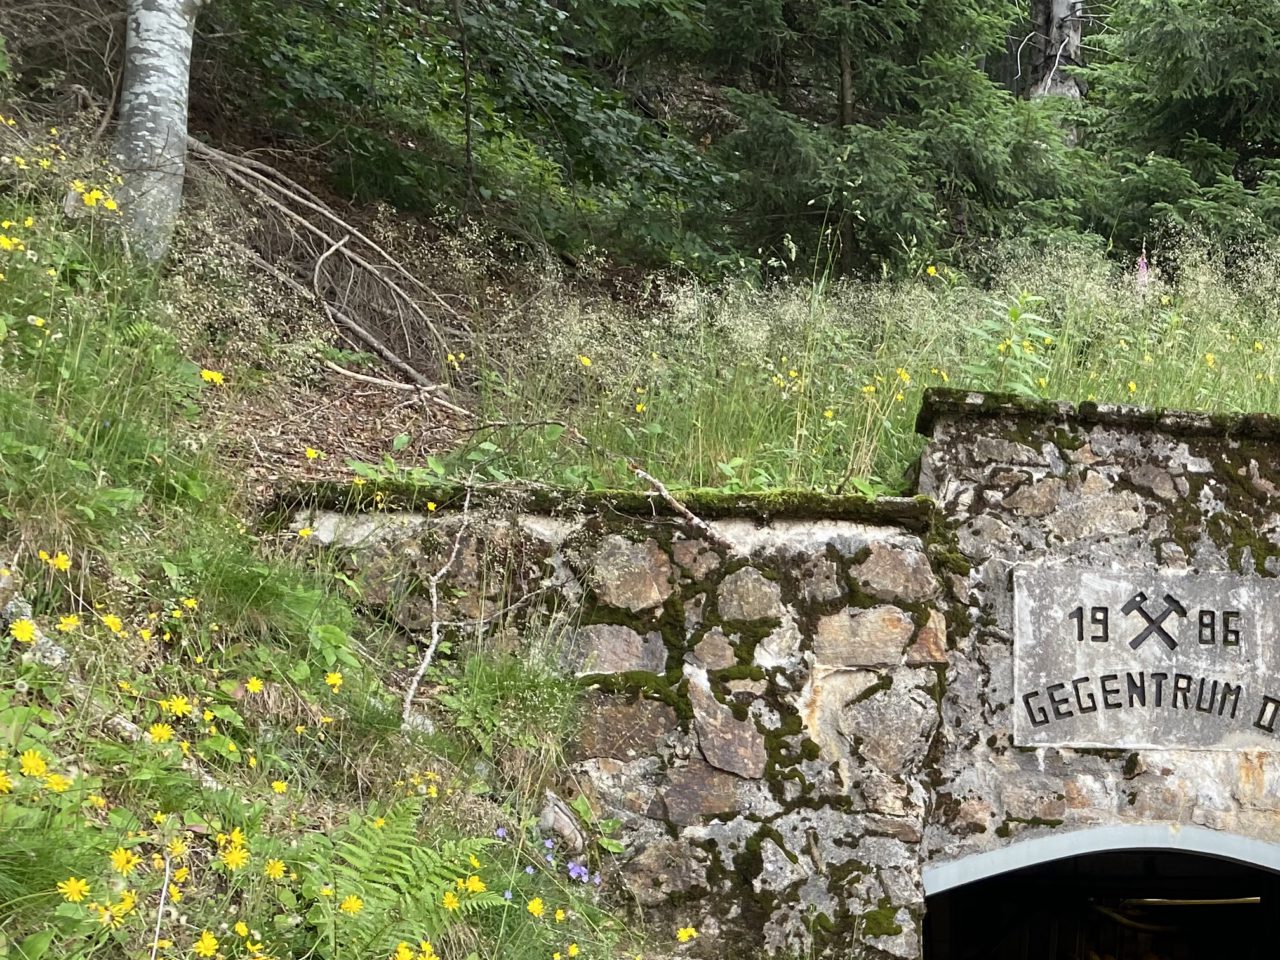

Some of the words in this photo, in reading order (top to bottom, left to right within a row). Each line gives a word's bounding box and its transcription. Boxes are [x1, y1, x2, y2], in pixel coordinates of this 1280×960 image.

[1068, 606, 1109, 642] 19
[1198, 610, 1240, 646] 86
[1021, 671, 1241, 728] GEGENTRUM
